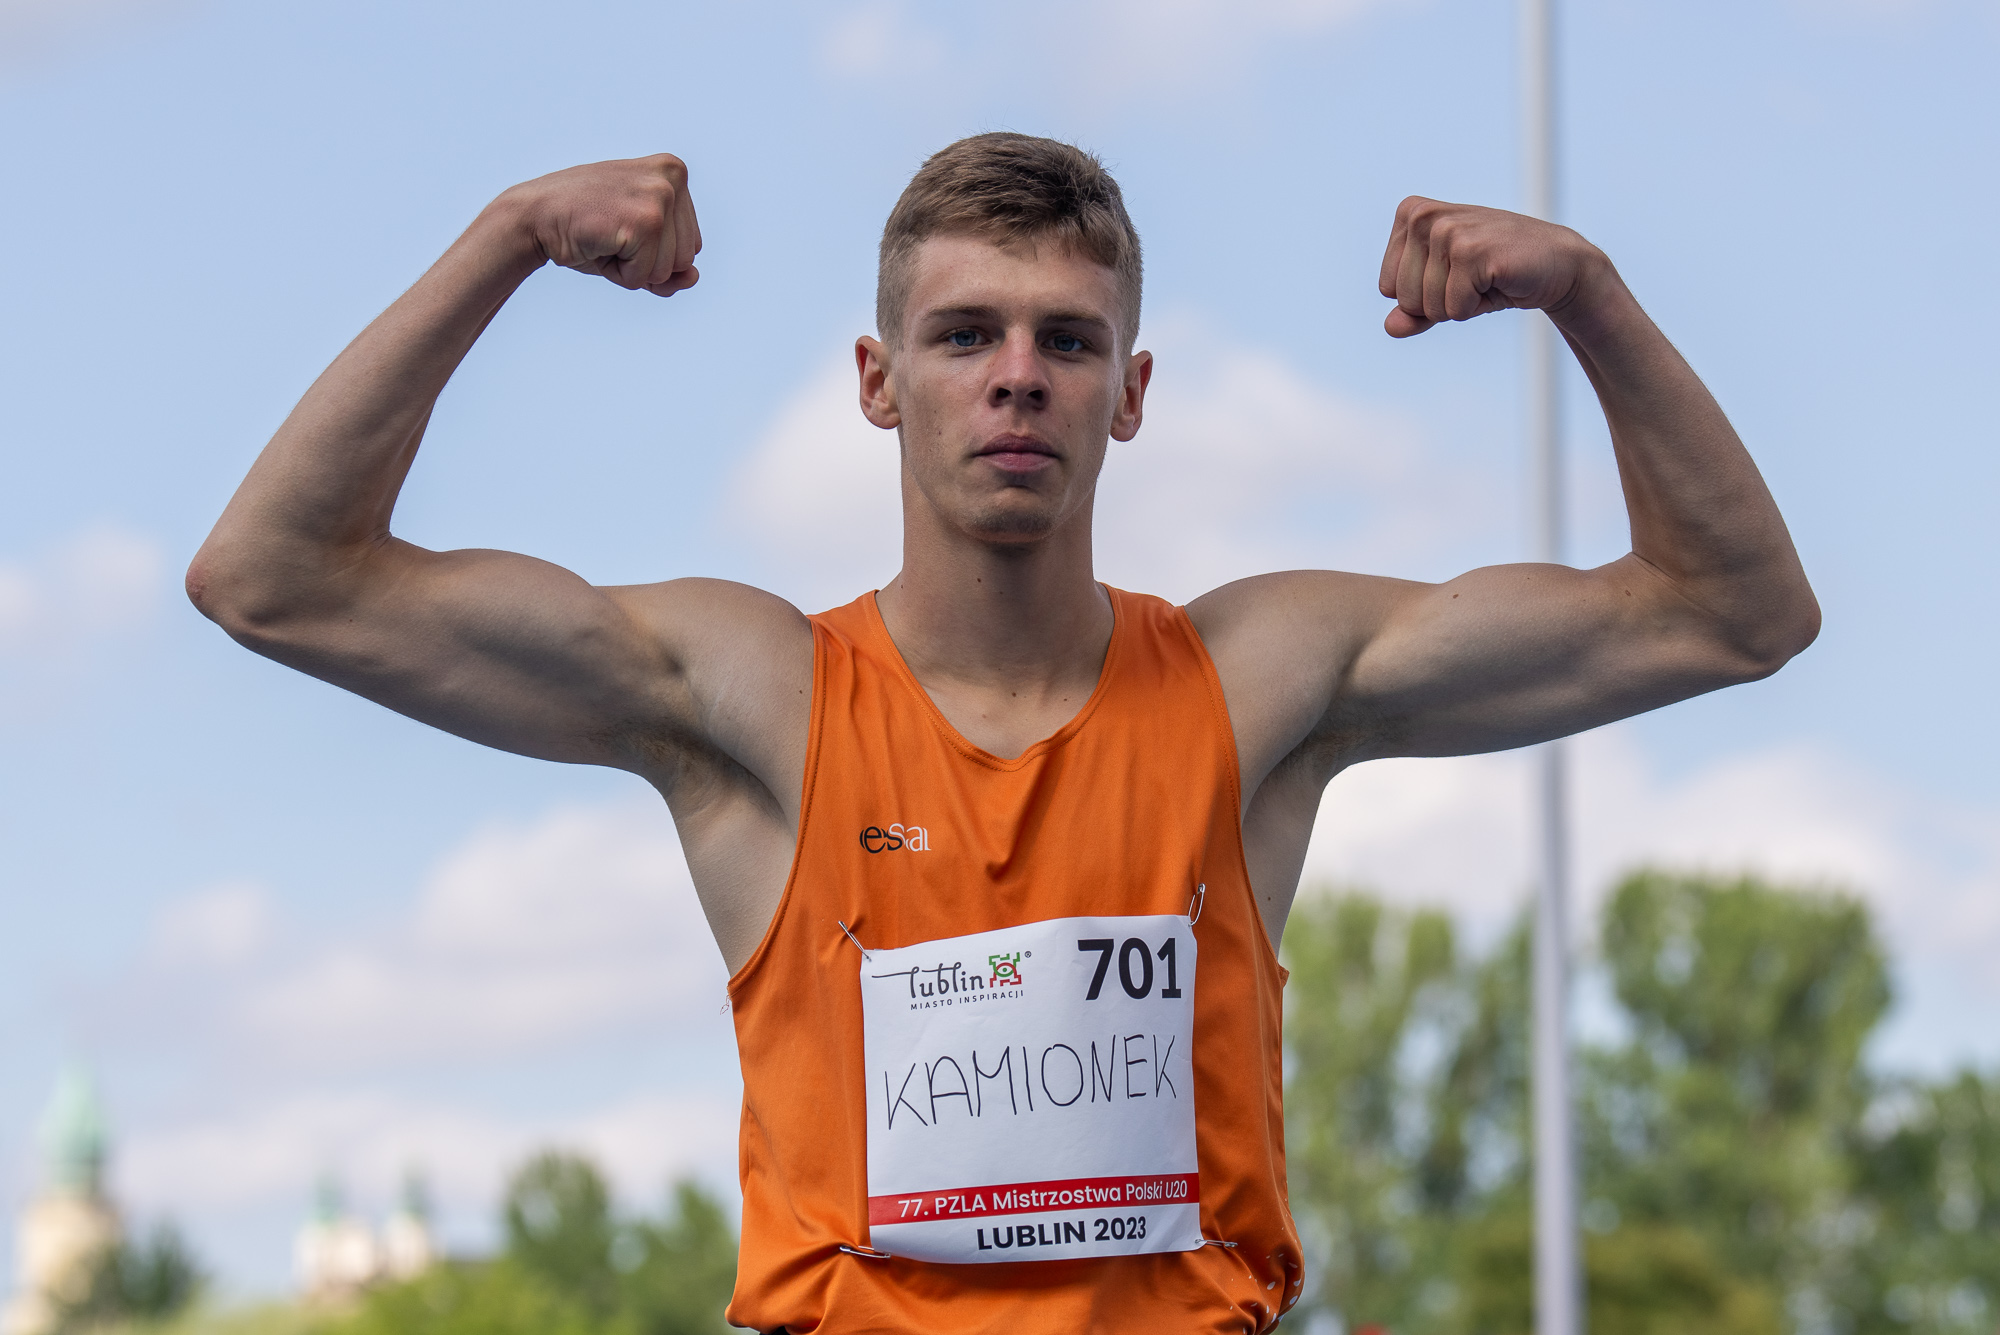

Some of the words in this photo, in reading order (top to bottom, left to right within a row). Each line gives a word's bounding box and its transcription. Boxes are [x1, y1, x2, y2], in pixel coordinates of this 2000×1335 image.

[1077, 937, 1182, 1001] 701
[910, 998, 953, 1010] MIASTO
[959, 989, 1024, 1004] INSPIRACJI
[884, 1034, 1177, 1130] KAMIONEK
[897, 1199, 929, 1218] 77.
[934, 1194, 987, 1215] PZLA
[992, 1184, 1121, 1211] Mistrzostwa
[1125, 1181, 1163, 1201] Polski
[1165, 1180, 1188, 1199] U20
[976, 1220, 1086, 1251] LUBLIN
[1094, 1216, 1147, 1242] 2023
